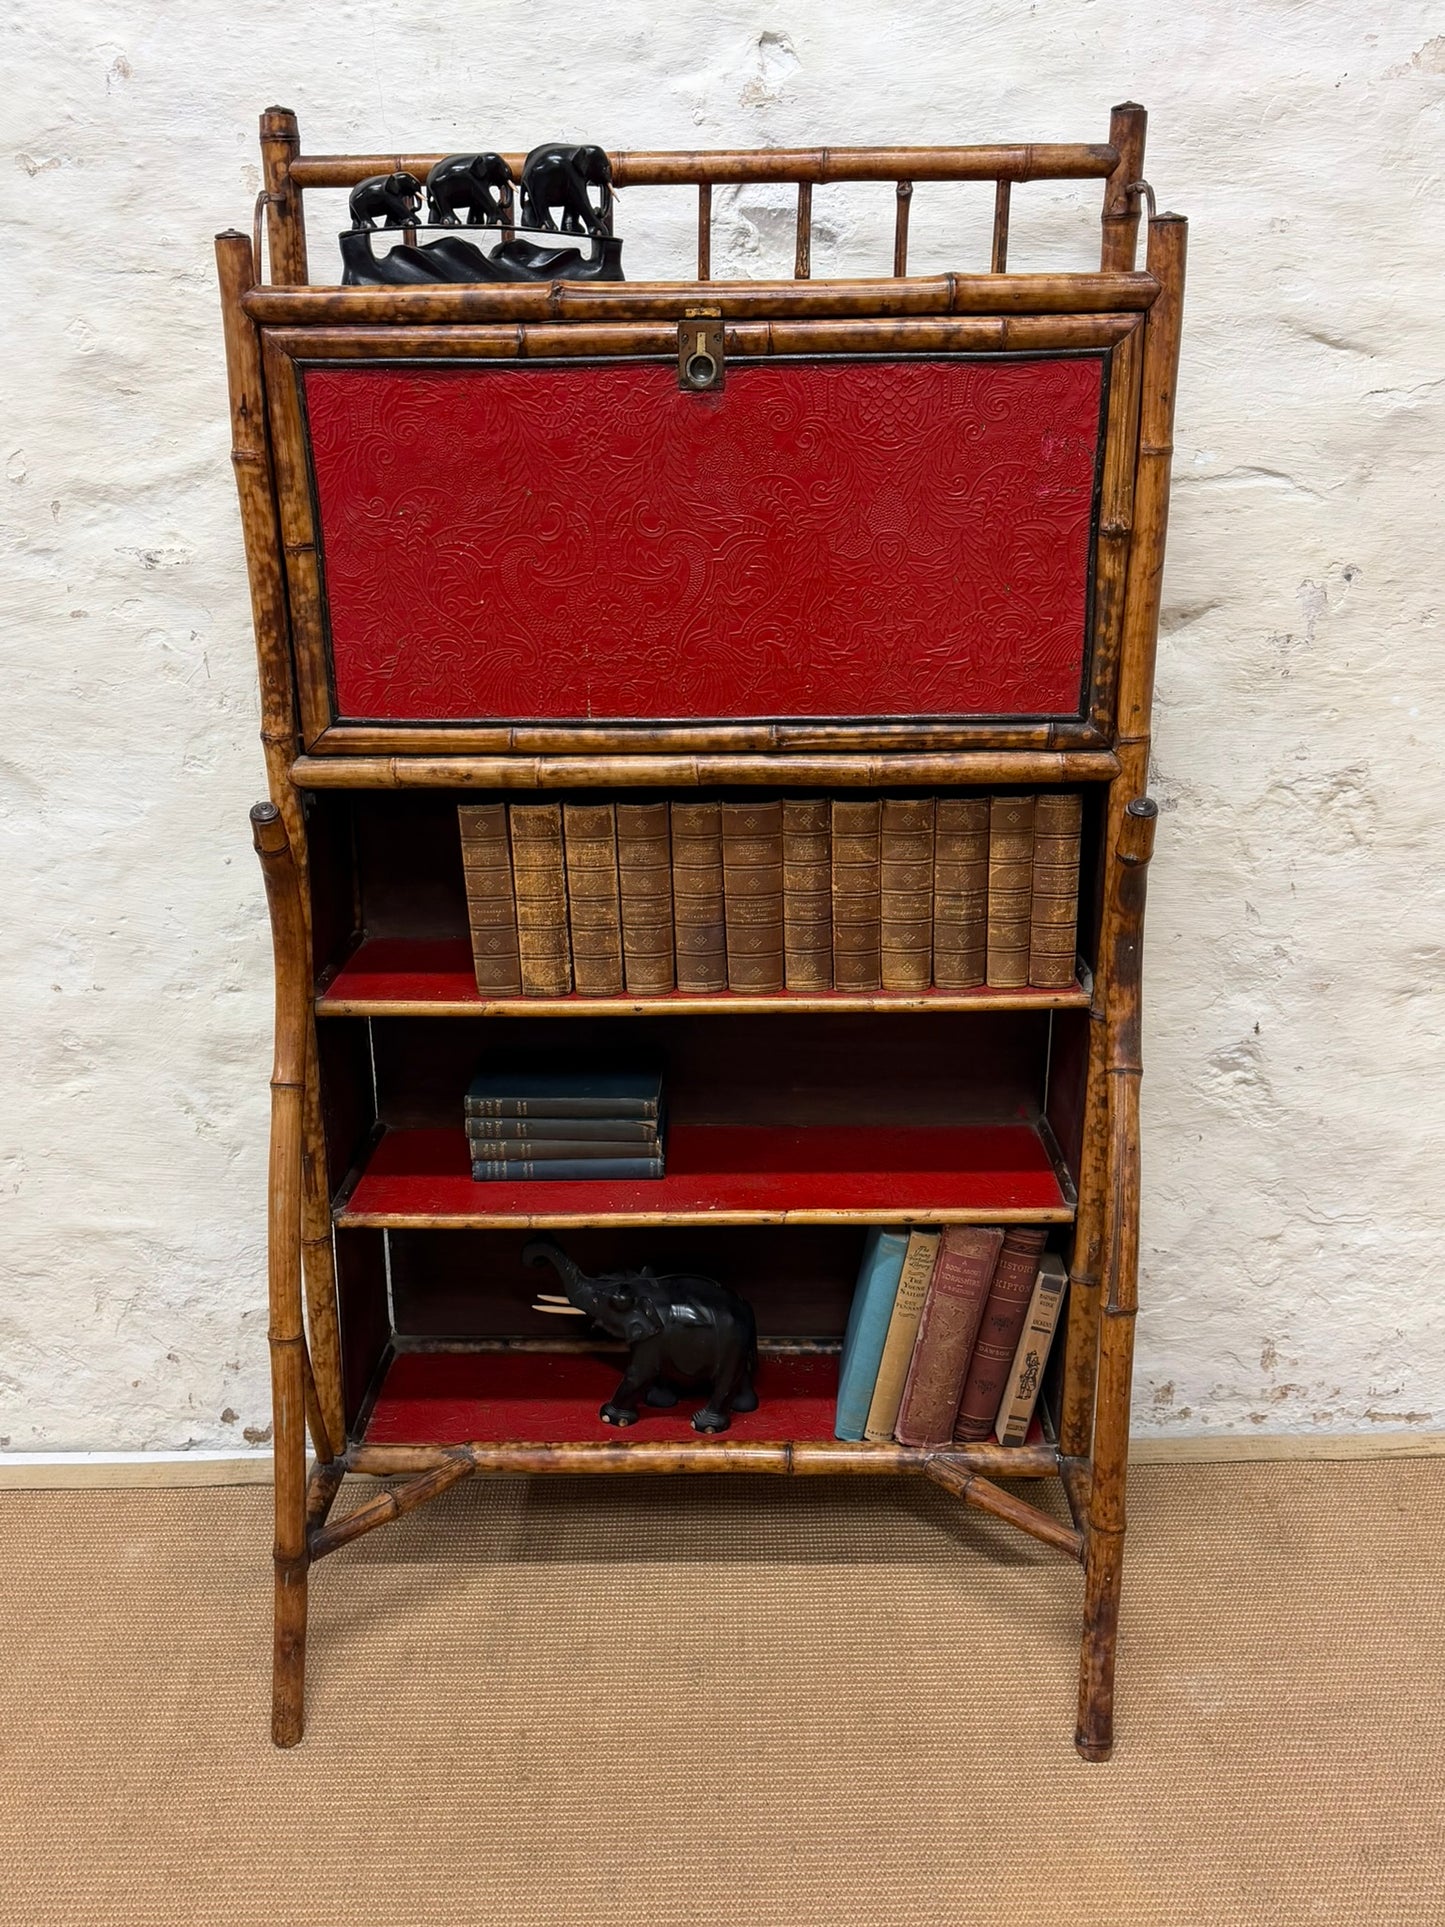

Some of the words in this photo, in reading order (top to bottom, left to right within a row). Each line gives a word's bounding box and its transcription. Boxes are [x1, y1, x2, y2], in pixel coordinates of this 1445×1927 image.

[945, 1263, 962, 1273] BOOK
[999, 1260, 1034, 1274] HISTORY
[909, 1276, 922, 1284] THE
[941, 1271, 983, 1287] YORKSHIRE
[903, 1281, 926, 1291] YOUNG
[900, 1288, 926, 1297] SAILOR
[978, 1344, 1010, 1357] DAWSON
